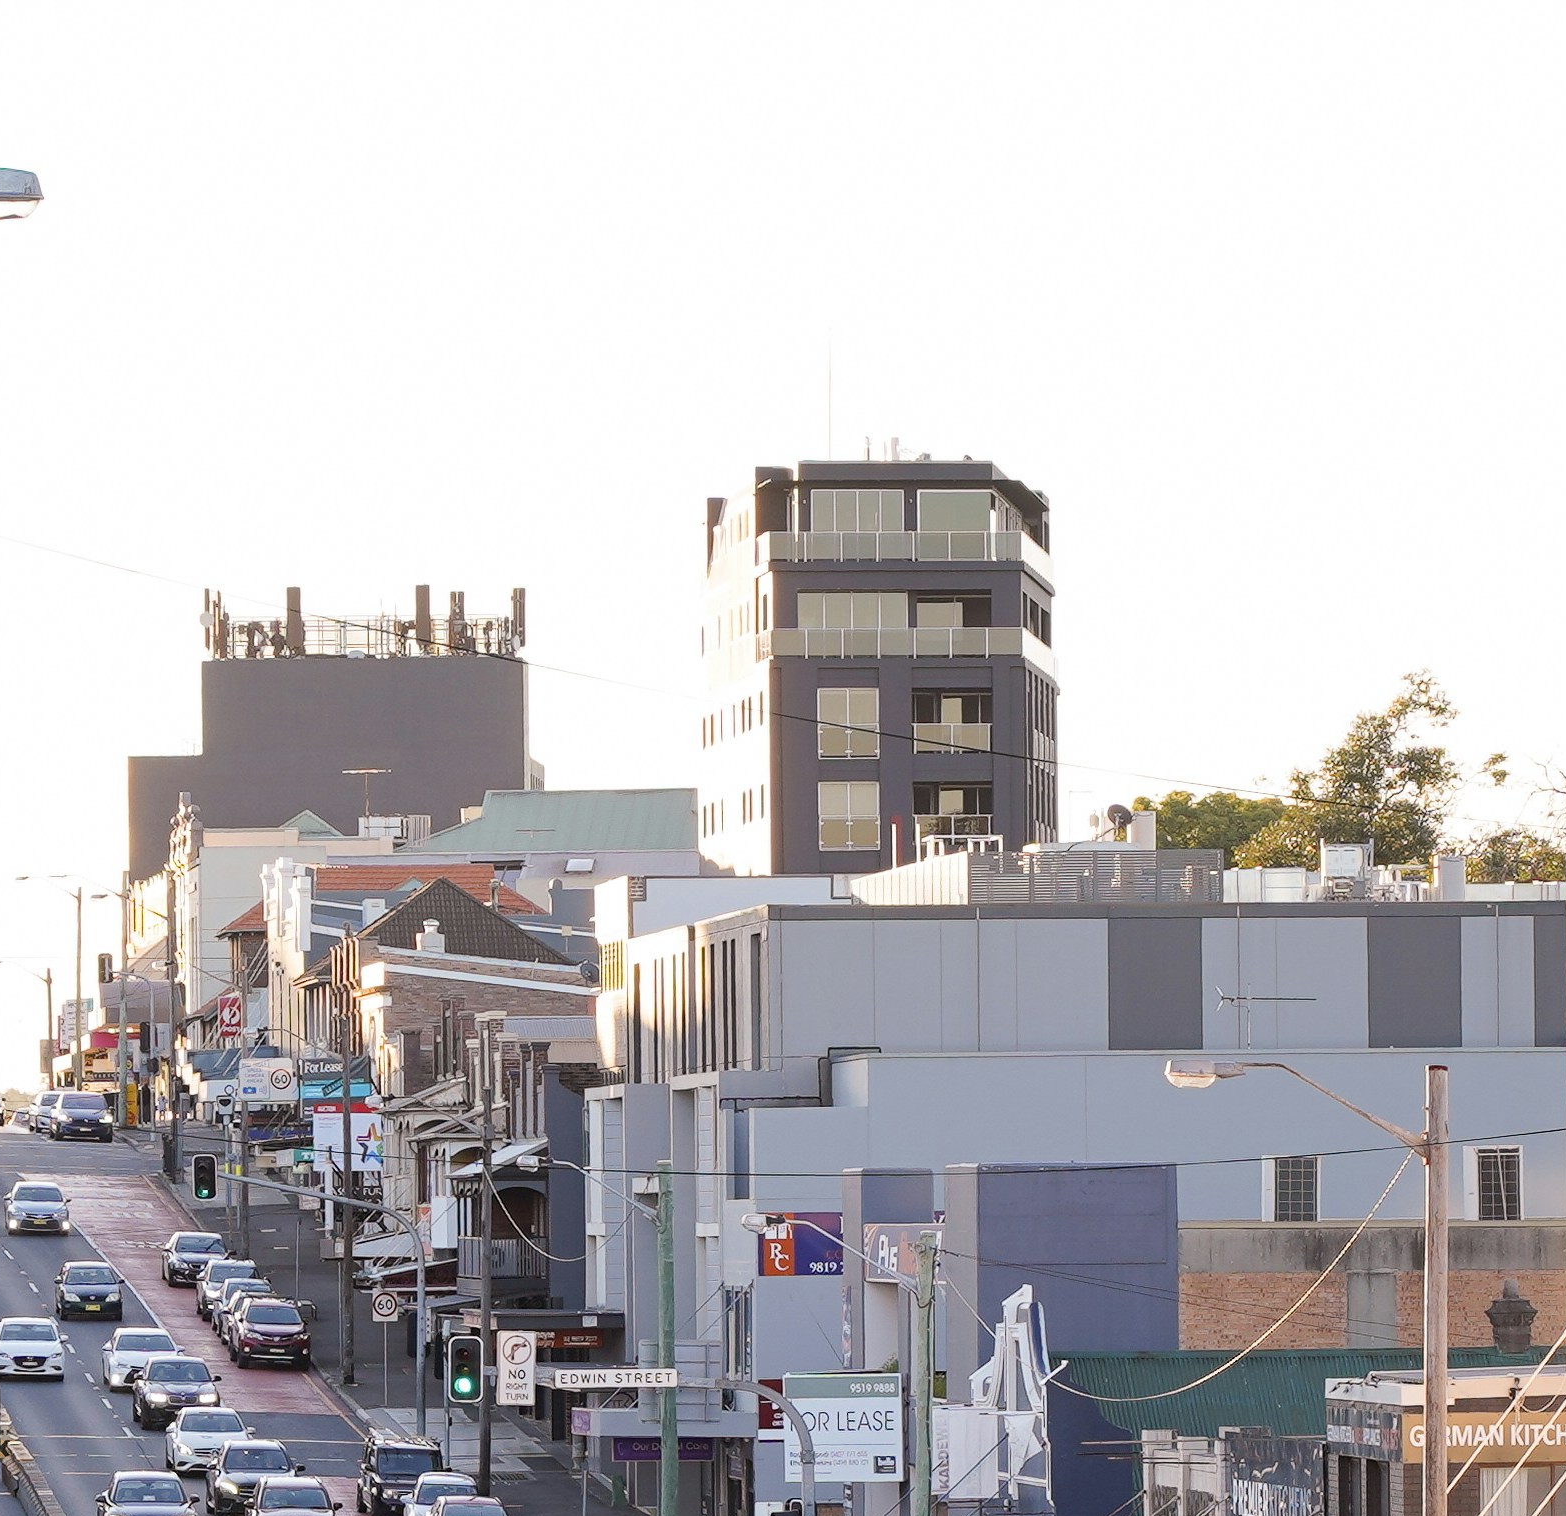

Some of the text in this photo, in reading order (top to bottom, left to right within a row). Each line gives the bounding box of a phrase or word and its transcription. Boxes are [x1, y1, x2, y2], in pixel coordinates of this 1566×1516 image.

[305, 1062, 344, 1073] For Lease
[275, 1074, 288, 1084] 60
[809, 1262, 837, 1273] 9819
[377, 1299, 393, 1311] 60
[508, 1369, 526, 1380] NO
[560, 1372, 673, 1384] EDWIN STREET
[506, 1382, 527, 1391] RIGHT
[505, 1393, 529, 1401] TURN
[790, 1411, 830, 1432] OR
[837, 1411, 895, 1431] LEASE
[1409, 1424, 1503, 1447] GRMAN
